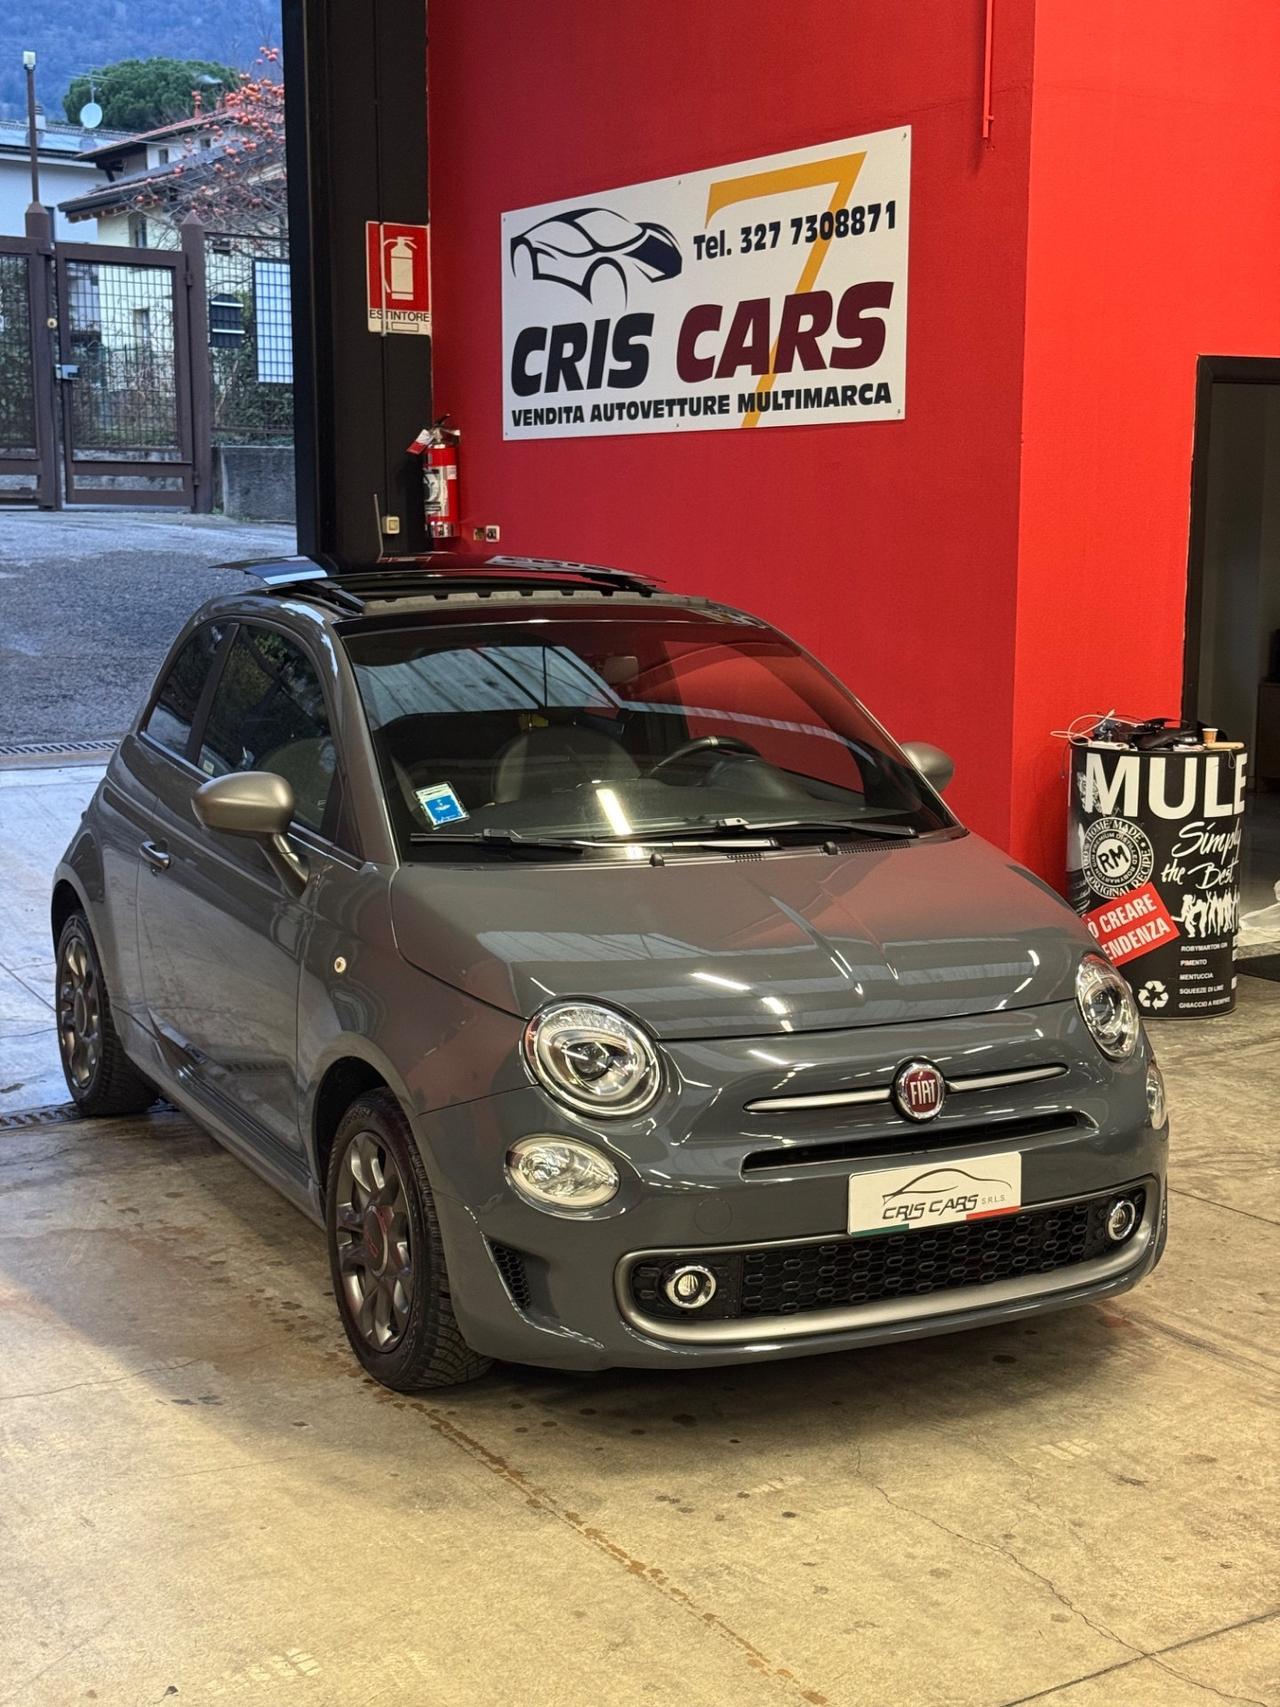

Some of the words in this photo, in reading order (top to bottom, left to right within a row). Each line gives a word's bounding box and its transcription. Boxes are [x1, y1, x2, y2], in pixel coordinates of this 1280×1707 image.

[693, 230, 732, 260] Tel.
[740, 221, 781, 254] 327
[790, 200, 896, 246] 7308871
[370, 310, 430, 322] ESTINTORE
[510, 312, 655, 397] CRIS
[675, 281, 894, 384] CARS
[511, 405, 585, 427] VENDITA
[590, 394, 730, 423] AUTOVETTURE
[737, 382, 892, 415] MULTIMARCA
[1084, 752, 1248, 820] MULE
[1086, 820, 1111, 842] HOME
[1112, 820, 1145, 843] MADE
[1088, 876, 1131, 897] ORIGINAL
[1131, 848, 1152, 889] RECIPE
[1098, 845, 1129, 873] RM
[1160, 859, 1186, 885] the
[1187, 857, 1239, 889] Best
[1099, 894, 1157, 933] CREARE
[1102, 917, 1171, 960] ENDENZA
[1179, 972, 1214, 980] MENTUCCIA
[910, 1079, 936, 1105] FIAT
[882, 1202, 926, 1221] CRIS
[929, 1194, 979, 1216] CARS
